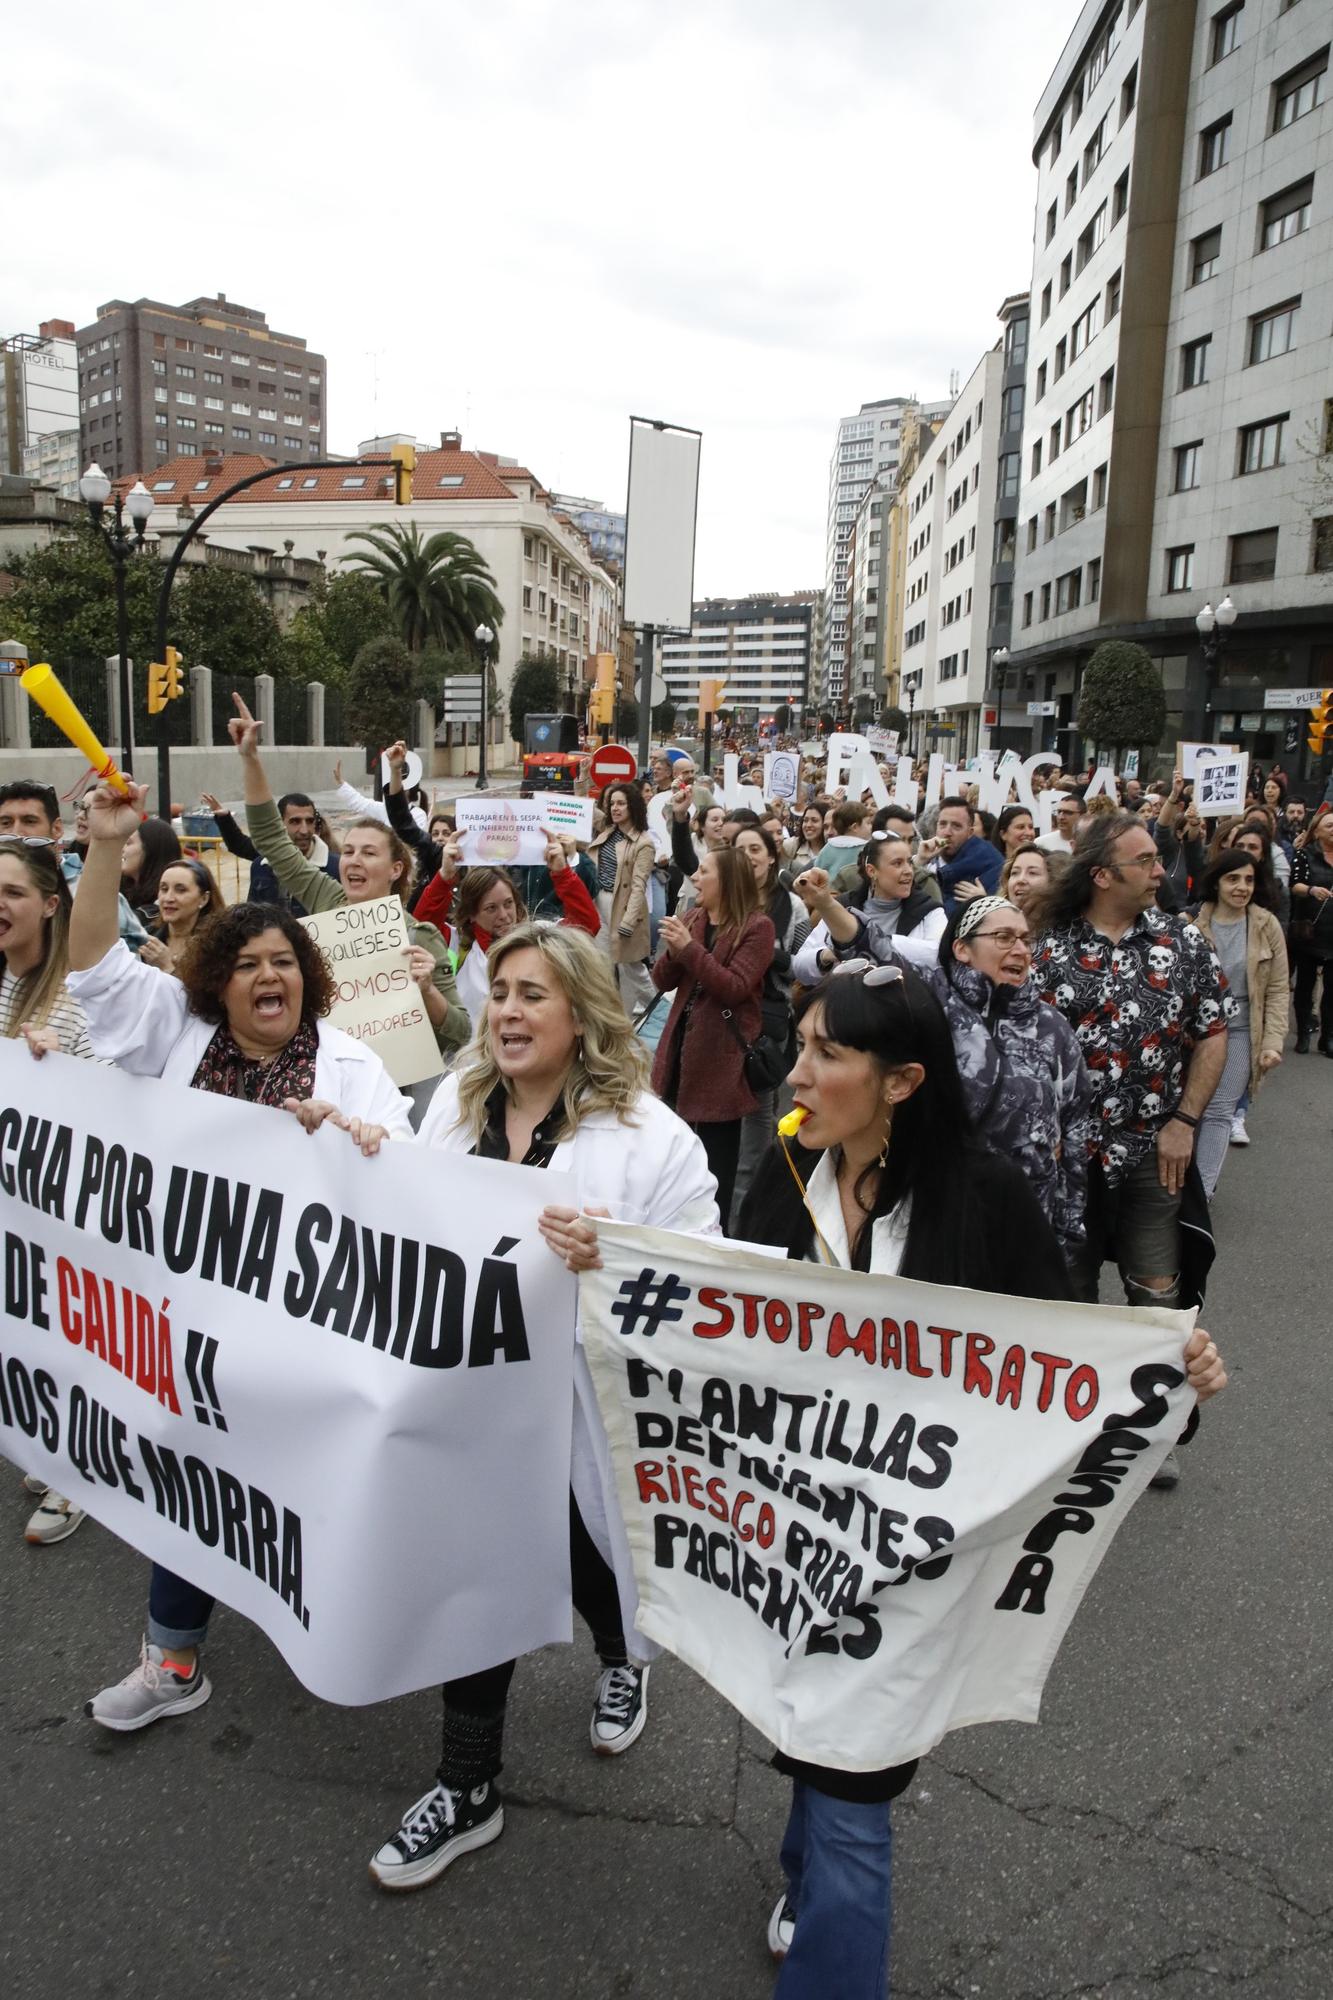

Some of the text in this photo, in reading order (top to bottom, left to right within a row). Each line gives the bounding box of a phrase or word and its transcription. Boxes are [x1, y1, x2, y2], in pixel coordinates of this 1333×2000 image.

[25, 352, 62, 369] HOTEL
[461, 814, 497, 822] TRABAJAR
[499, 814, 509, 822] EN
[511, 814, 519, 822] EL
[468, 824, 535, 832] EL INFIERNO EN EL
[306, 899, 401, 942] O SOMOS
[321, 928, 402, 962] RQUESES
[341, 1009, 423, 1040] AJADORES
[0, 1107, 531, 1369] CHA POR UNA SANIDÁ
[5, 1230, 50, 1331] DE
[56, 1255, 182, 1417] CALIDÁ
[610, 1267, 1099, 1422] #STOPMALTRATO
[68, 1384, 144, 1502] QUE
[137, 1433, 310, 1632] MORRA.
[653, 1513, 883, 1661] PACIENTES
[785, 1520, 864, 1619] PARA
